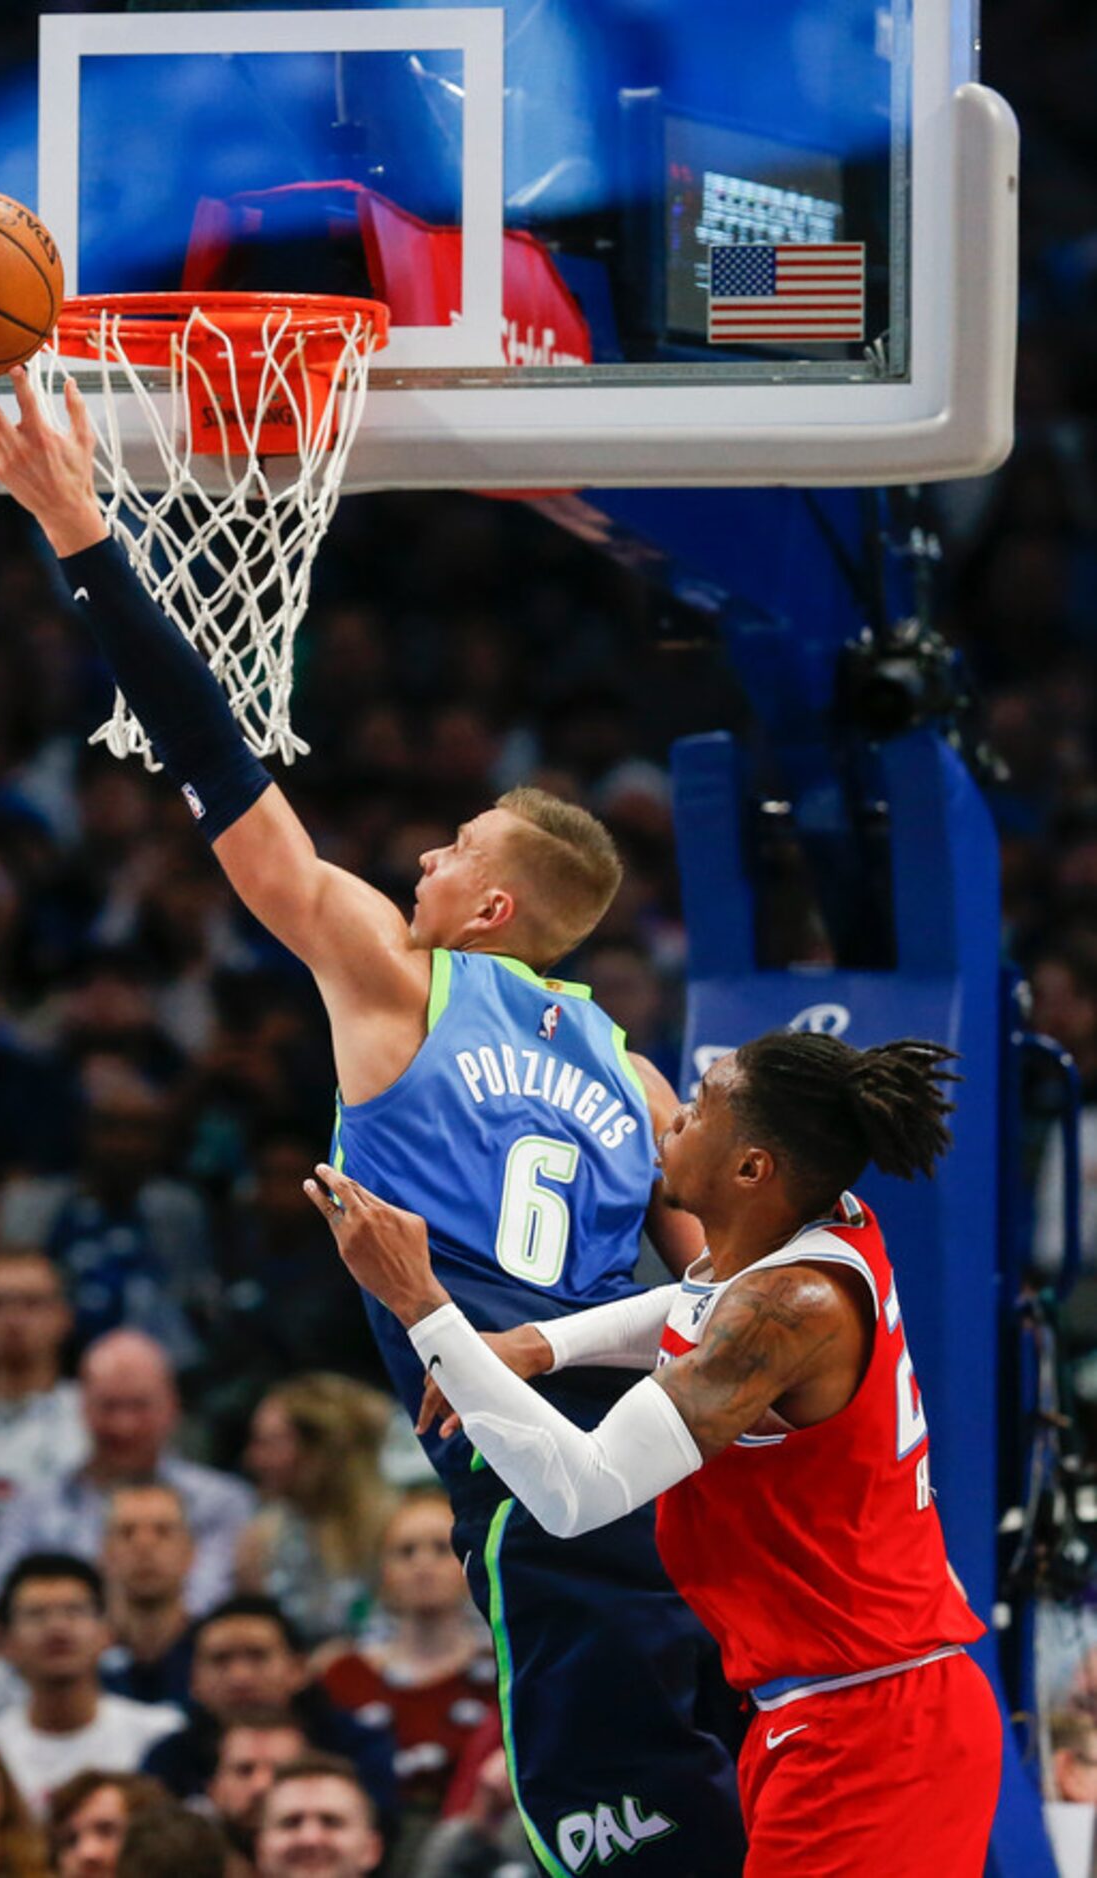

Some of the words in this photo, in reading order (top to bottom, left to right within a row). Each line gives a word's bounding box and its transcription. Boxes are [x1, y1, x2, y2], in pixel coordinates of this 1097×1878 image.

[455, 1043, 639, 1149] PORZINGIS
[494, 1134, 580, 1288] 6
[556, 1795, 679, 1875] DAL
